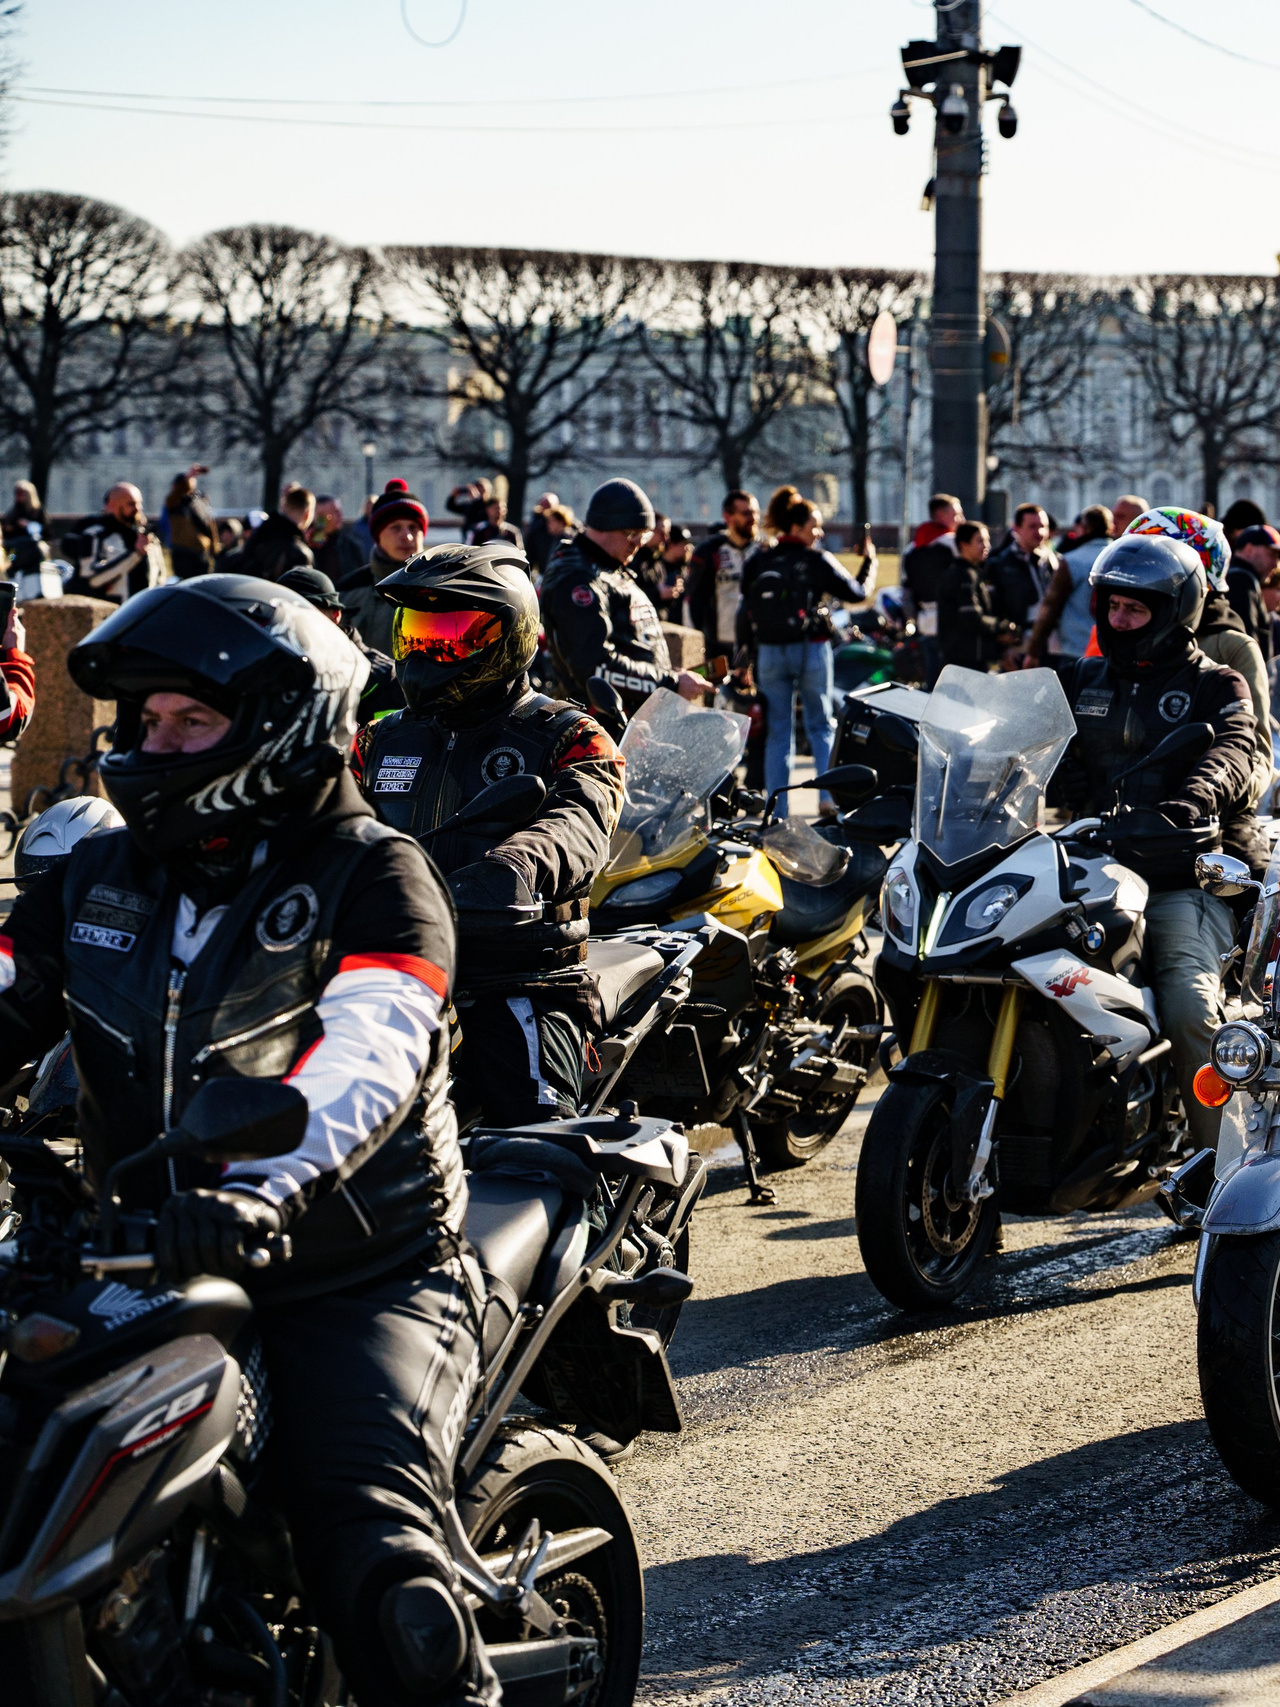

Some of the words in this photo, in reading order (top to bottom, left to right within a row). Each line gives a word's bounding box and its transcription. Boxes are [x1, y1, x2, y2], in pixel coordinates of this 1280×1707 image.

[380, 782, 405, 791] MEMBER
[1044, 966, 1074, 988] S1000
[1046, 966, 1093, 998] XR
[103, 1289, 187, 1331] HONDA
[119, 1381, 210, 1448] CB
